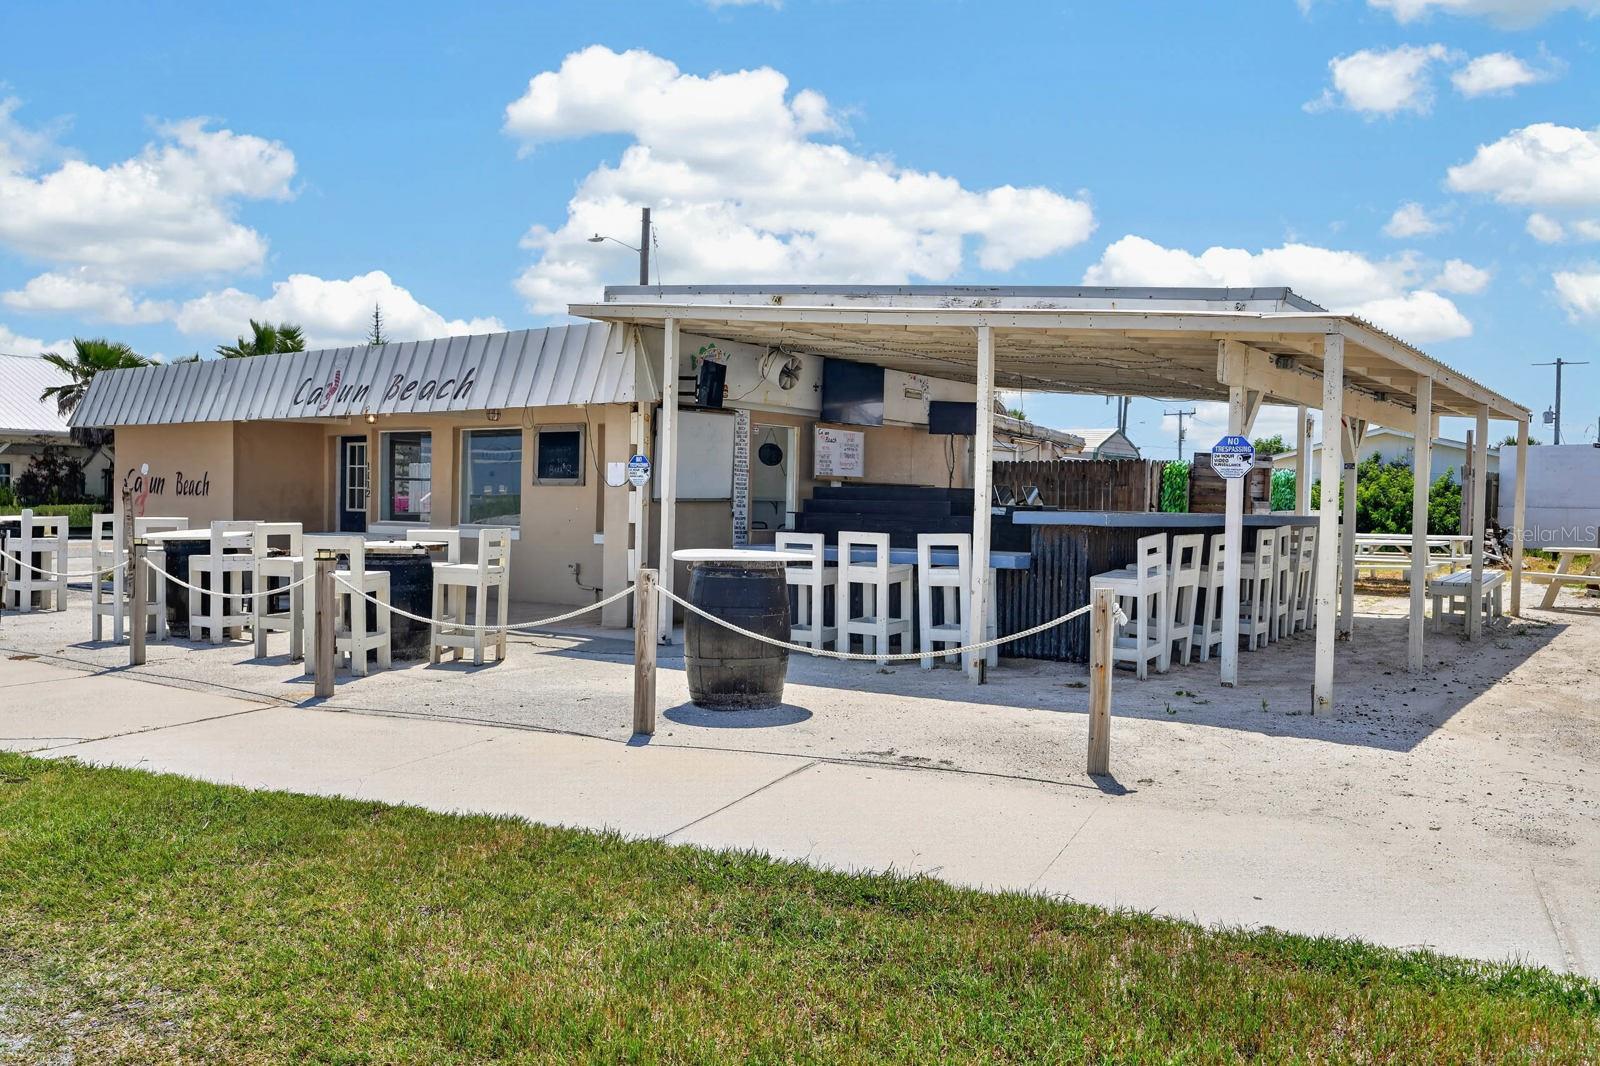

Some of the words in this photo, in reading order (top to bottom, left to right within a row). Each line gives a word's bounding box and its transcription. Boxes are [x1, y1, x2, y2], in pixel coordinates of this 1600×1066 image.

[383, 367, 476, 405] Beach
[1227, 437, 1239, 445] NO
[175, 470, 210, 497] Beach
